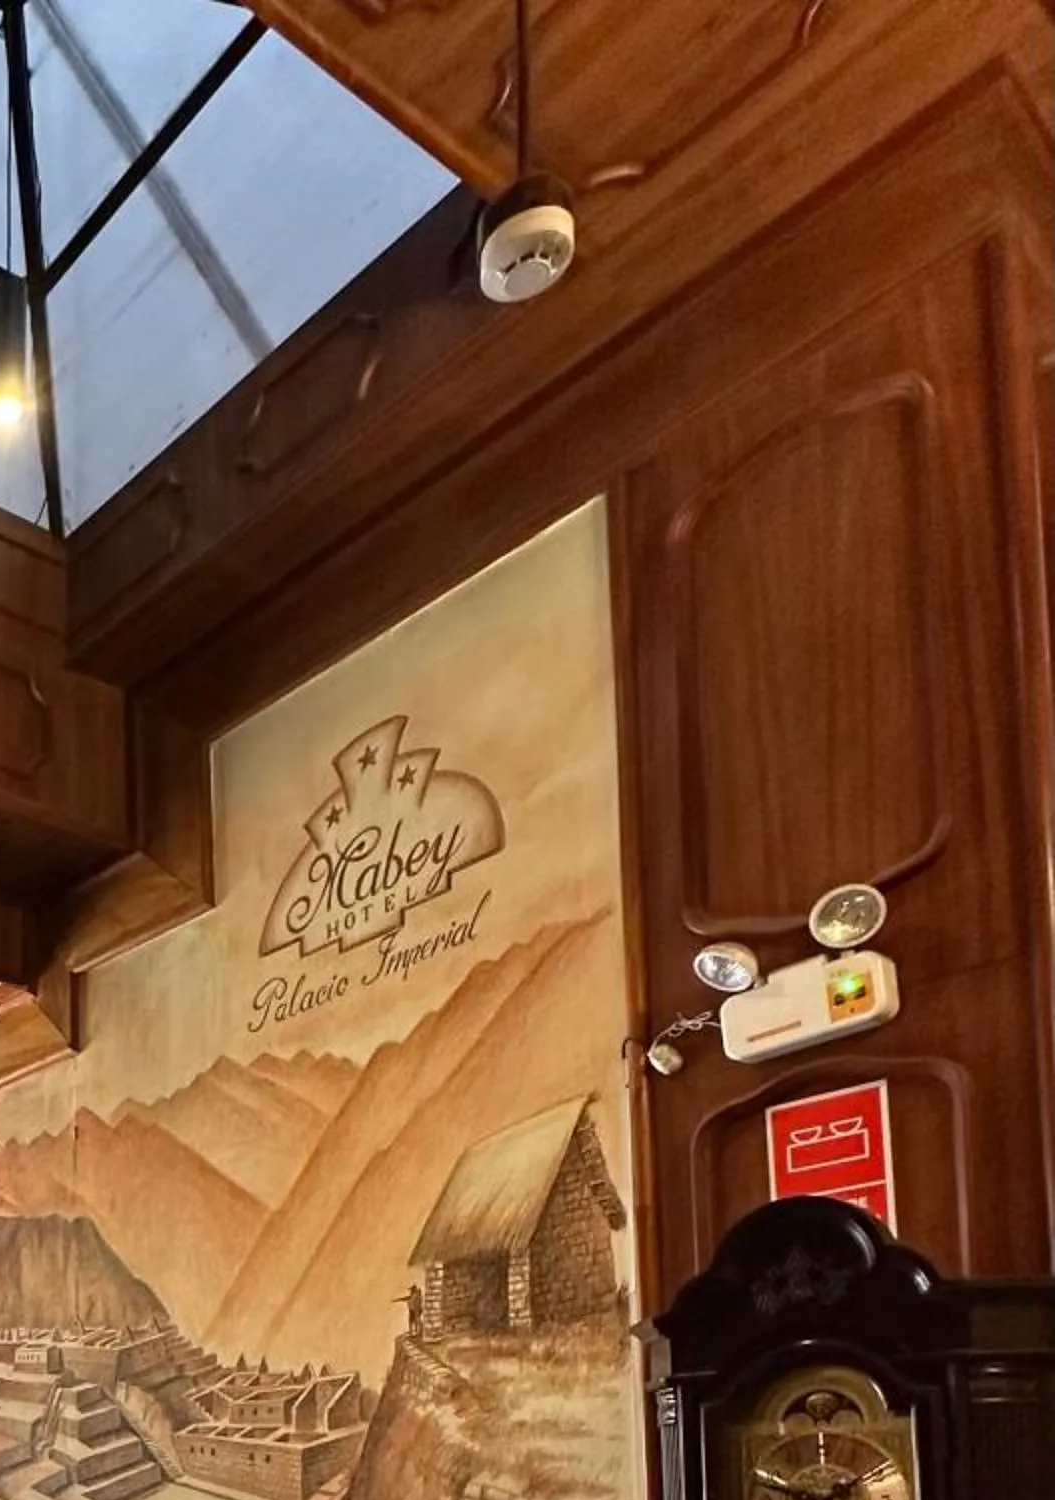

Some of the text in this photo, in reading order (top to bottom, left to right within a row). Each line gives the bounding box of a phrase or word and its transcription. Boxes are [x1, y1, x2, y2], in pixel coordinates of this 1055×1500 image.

[286, 819, 461, 933] Mabey
[325, 886, 416, 938] HOTEL
[247, 889, 491, 1033] Palacio Imperial
